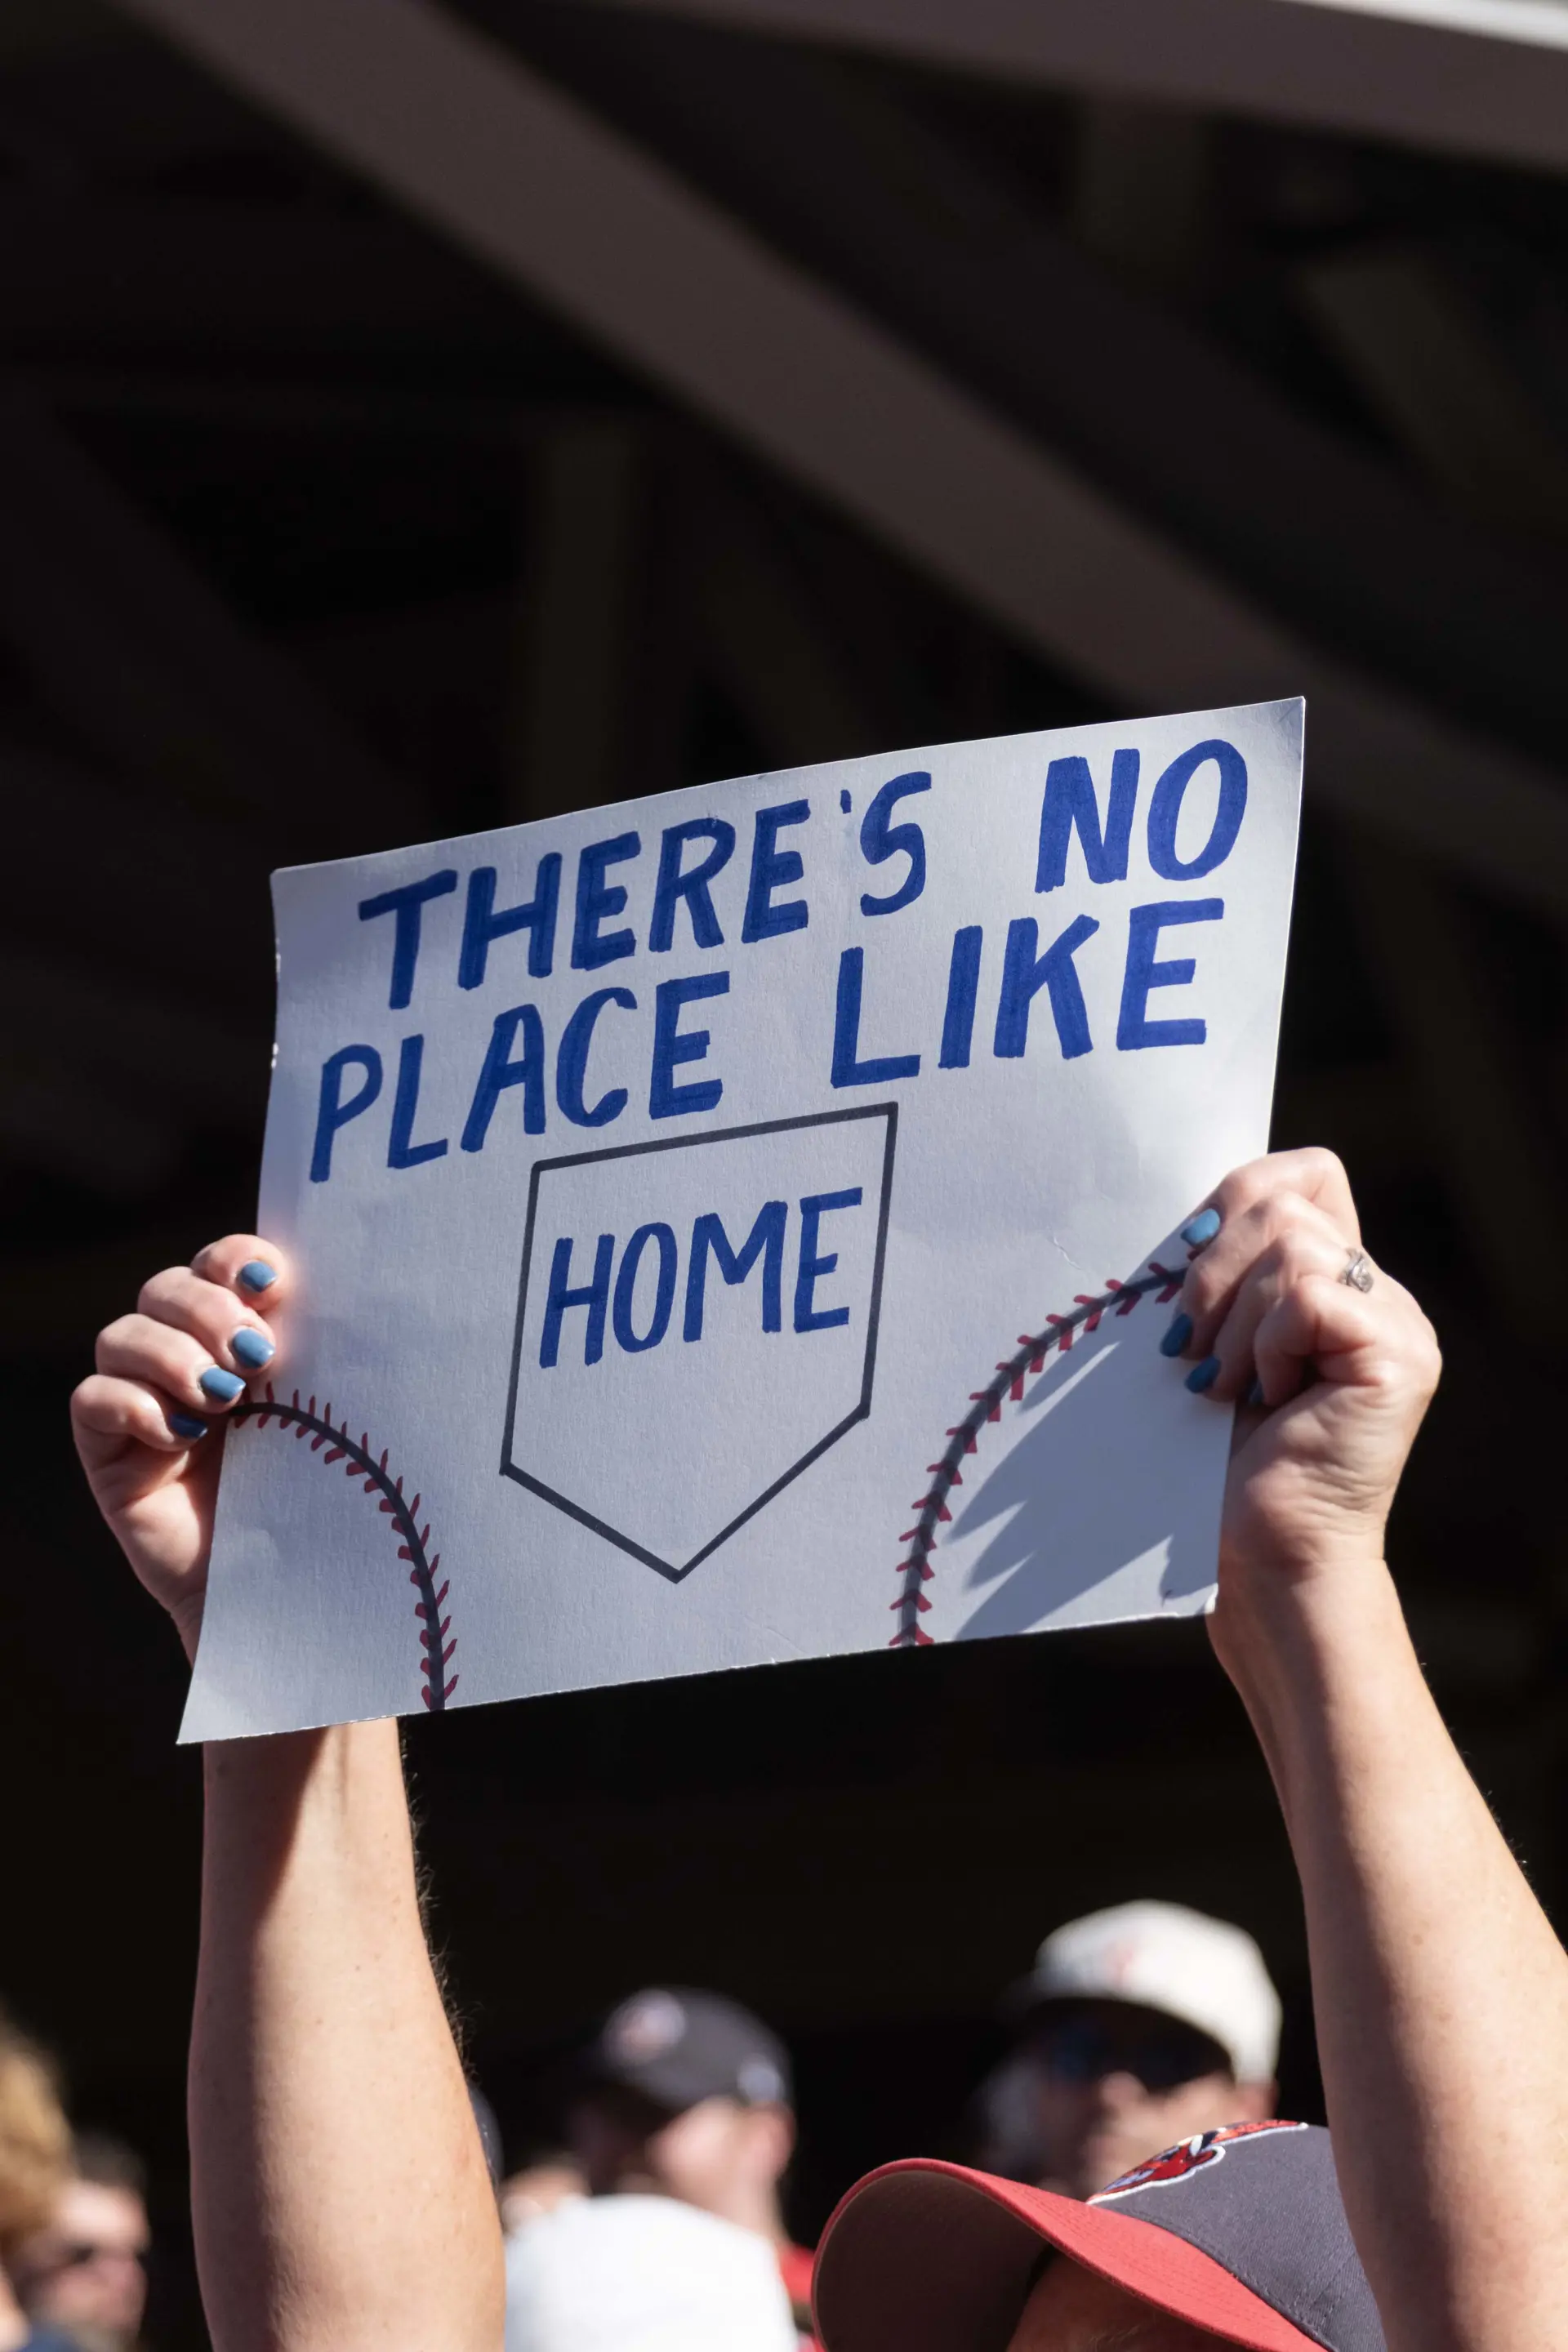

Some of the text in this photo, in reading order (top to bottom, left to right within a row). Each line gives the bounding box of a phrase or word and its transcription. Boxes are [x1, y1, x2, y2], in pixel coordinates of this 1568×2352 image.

[358, 738, 1248, 1012] THERE'S NO
[308, 898, 1225, 1185] PLACE LIKE
[538, 1187, 862, 1370] HOME
